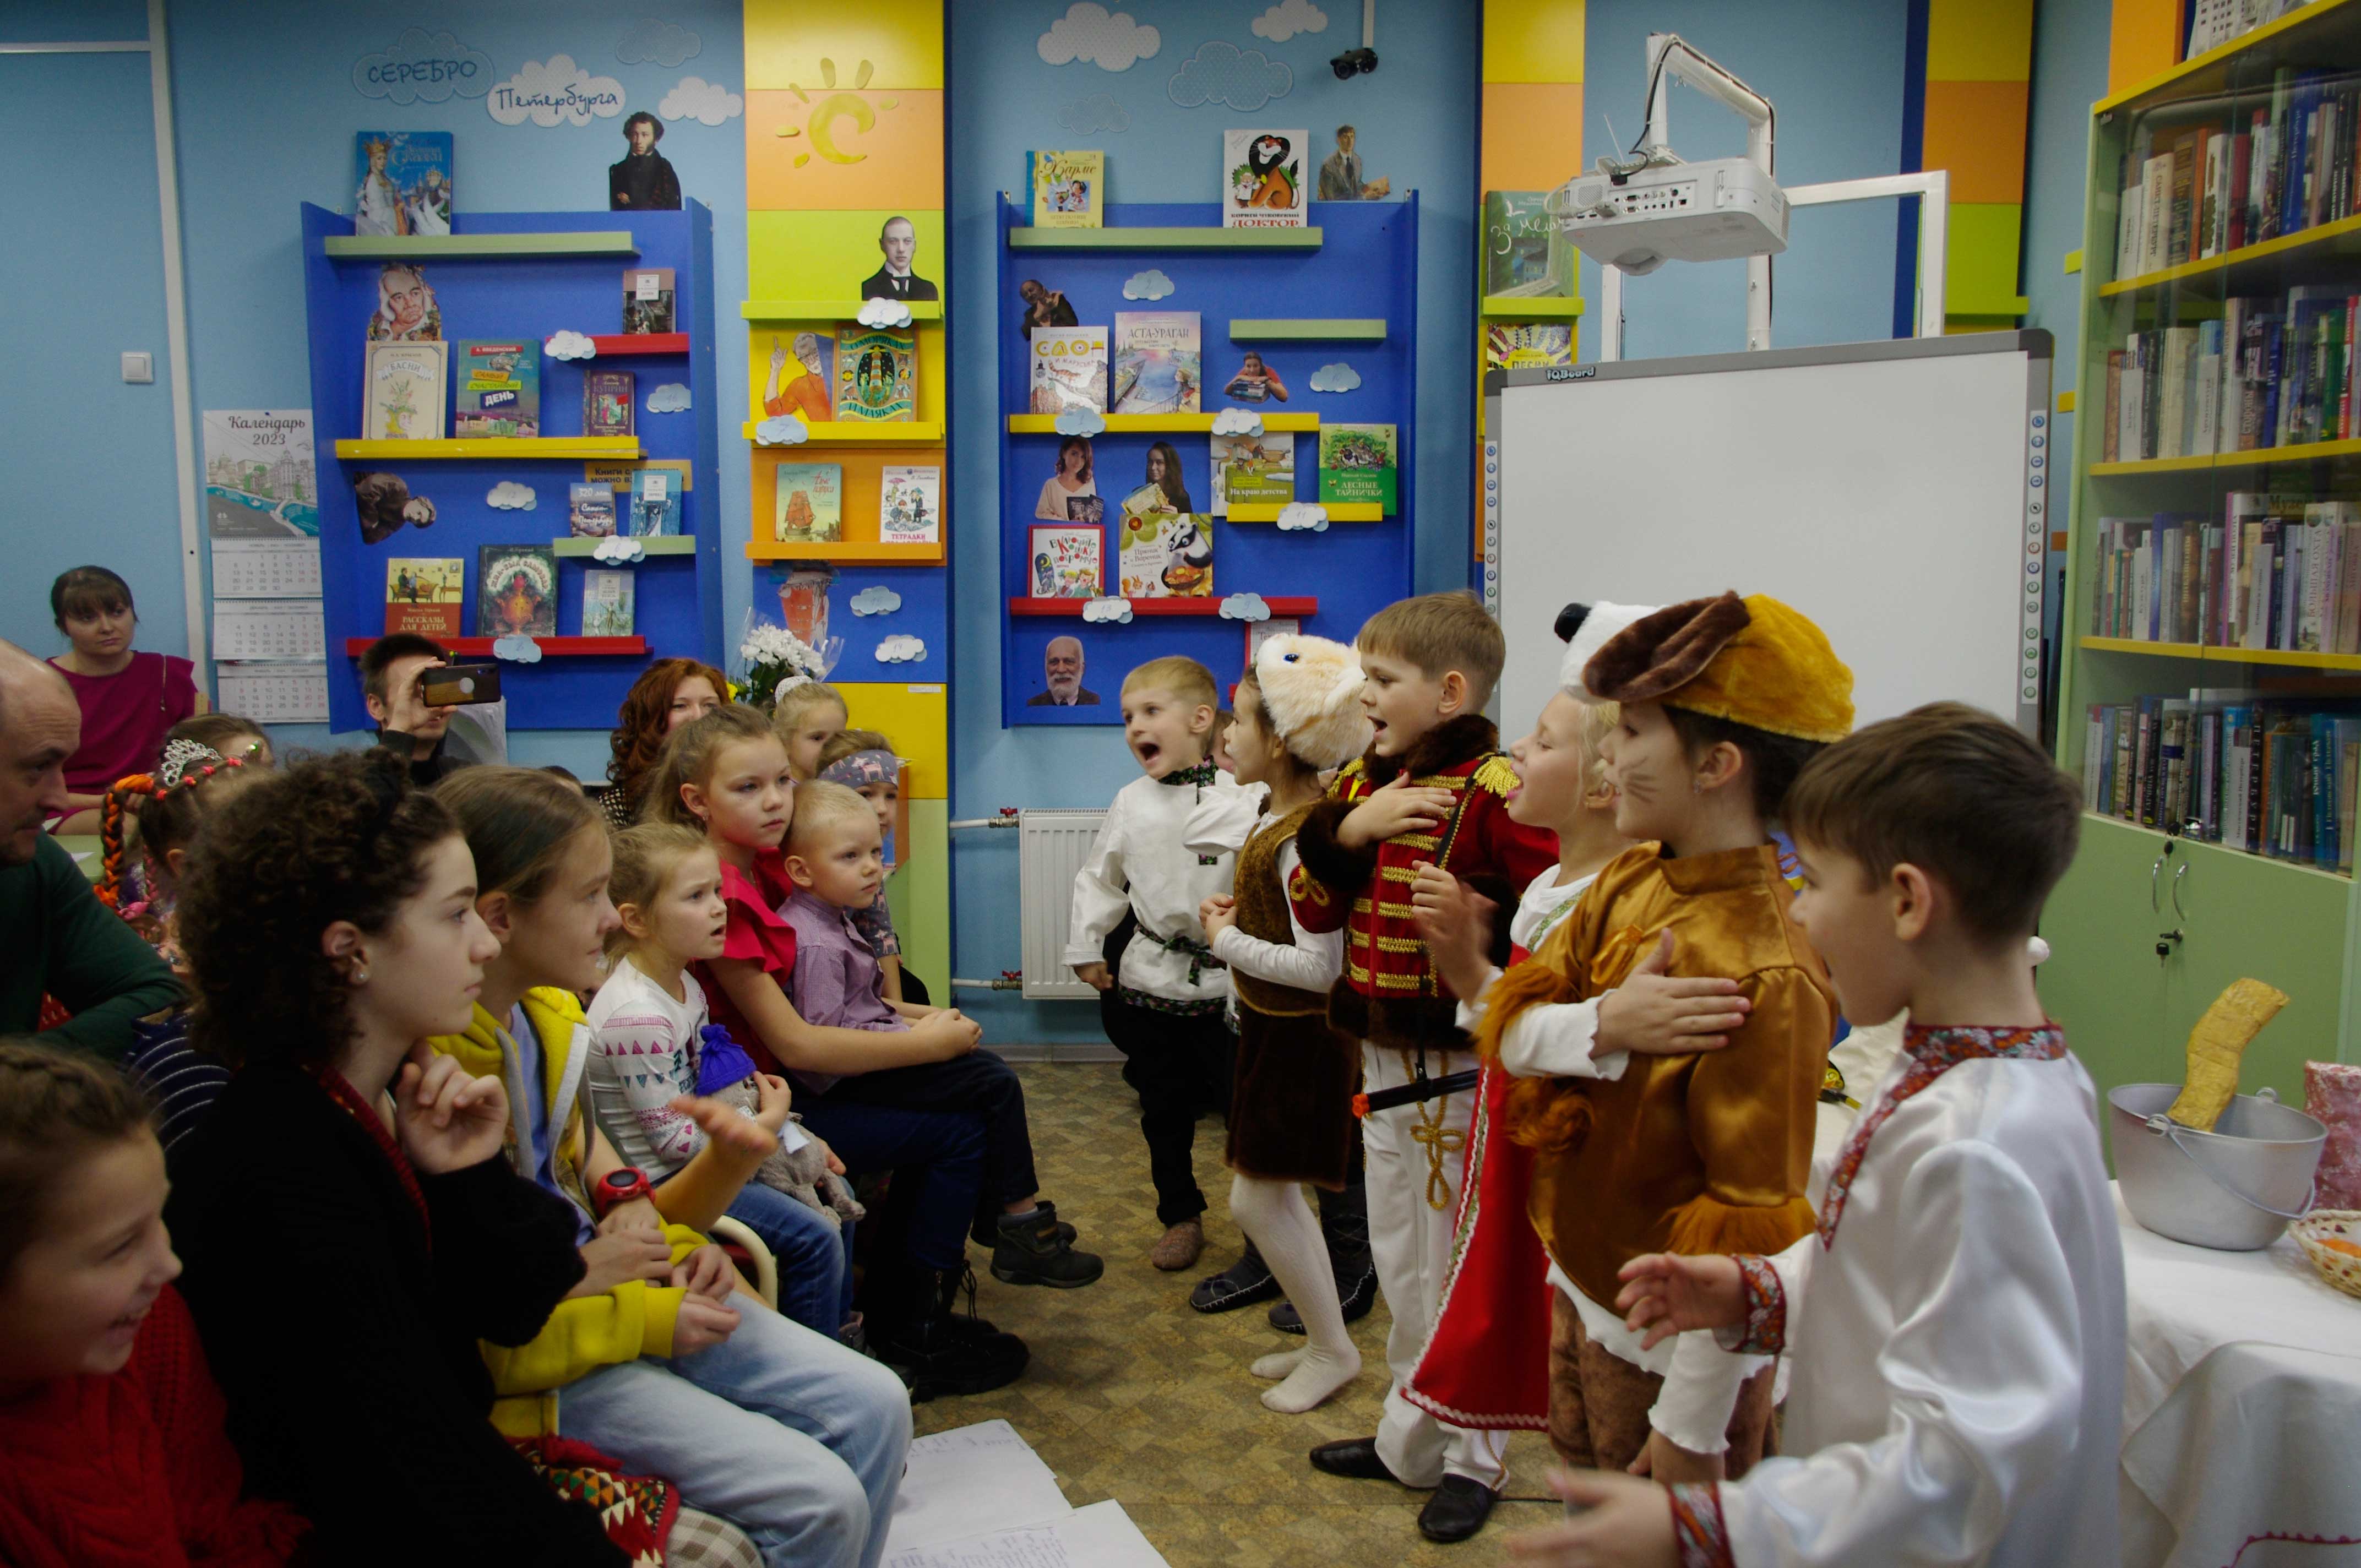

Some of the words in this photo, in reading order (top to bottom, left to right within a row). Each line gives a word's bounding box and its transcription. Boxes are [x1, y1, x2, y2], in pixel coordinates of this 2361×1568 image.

[368, 60, 477, 83] СЕРЕБРО
[495, 83, 618, 116] Петербурга
[1232, 220, 1300, 228] ДОКТОР
[1127, 328, 1189, 339] АСТА-УРАГАН
[1036, 340, 1105, 357] СЛОН
[390, 361, 422, 372] БАСНИ
[485, 391, 515, 407] ДЕНЬ
[229, 416, 306, 434] Календарь
[252, 433, 286, 445] 2023
[578, 487, 593, 497] 320
